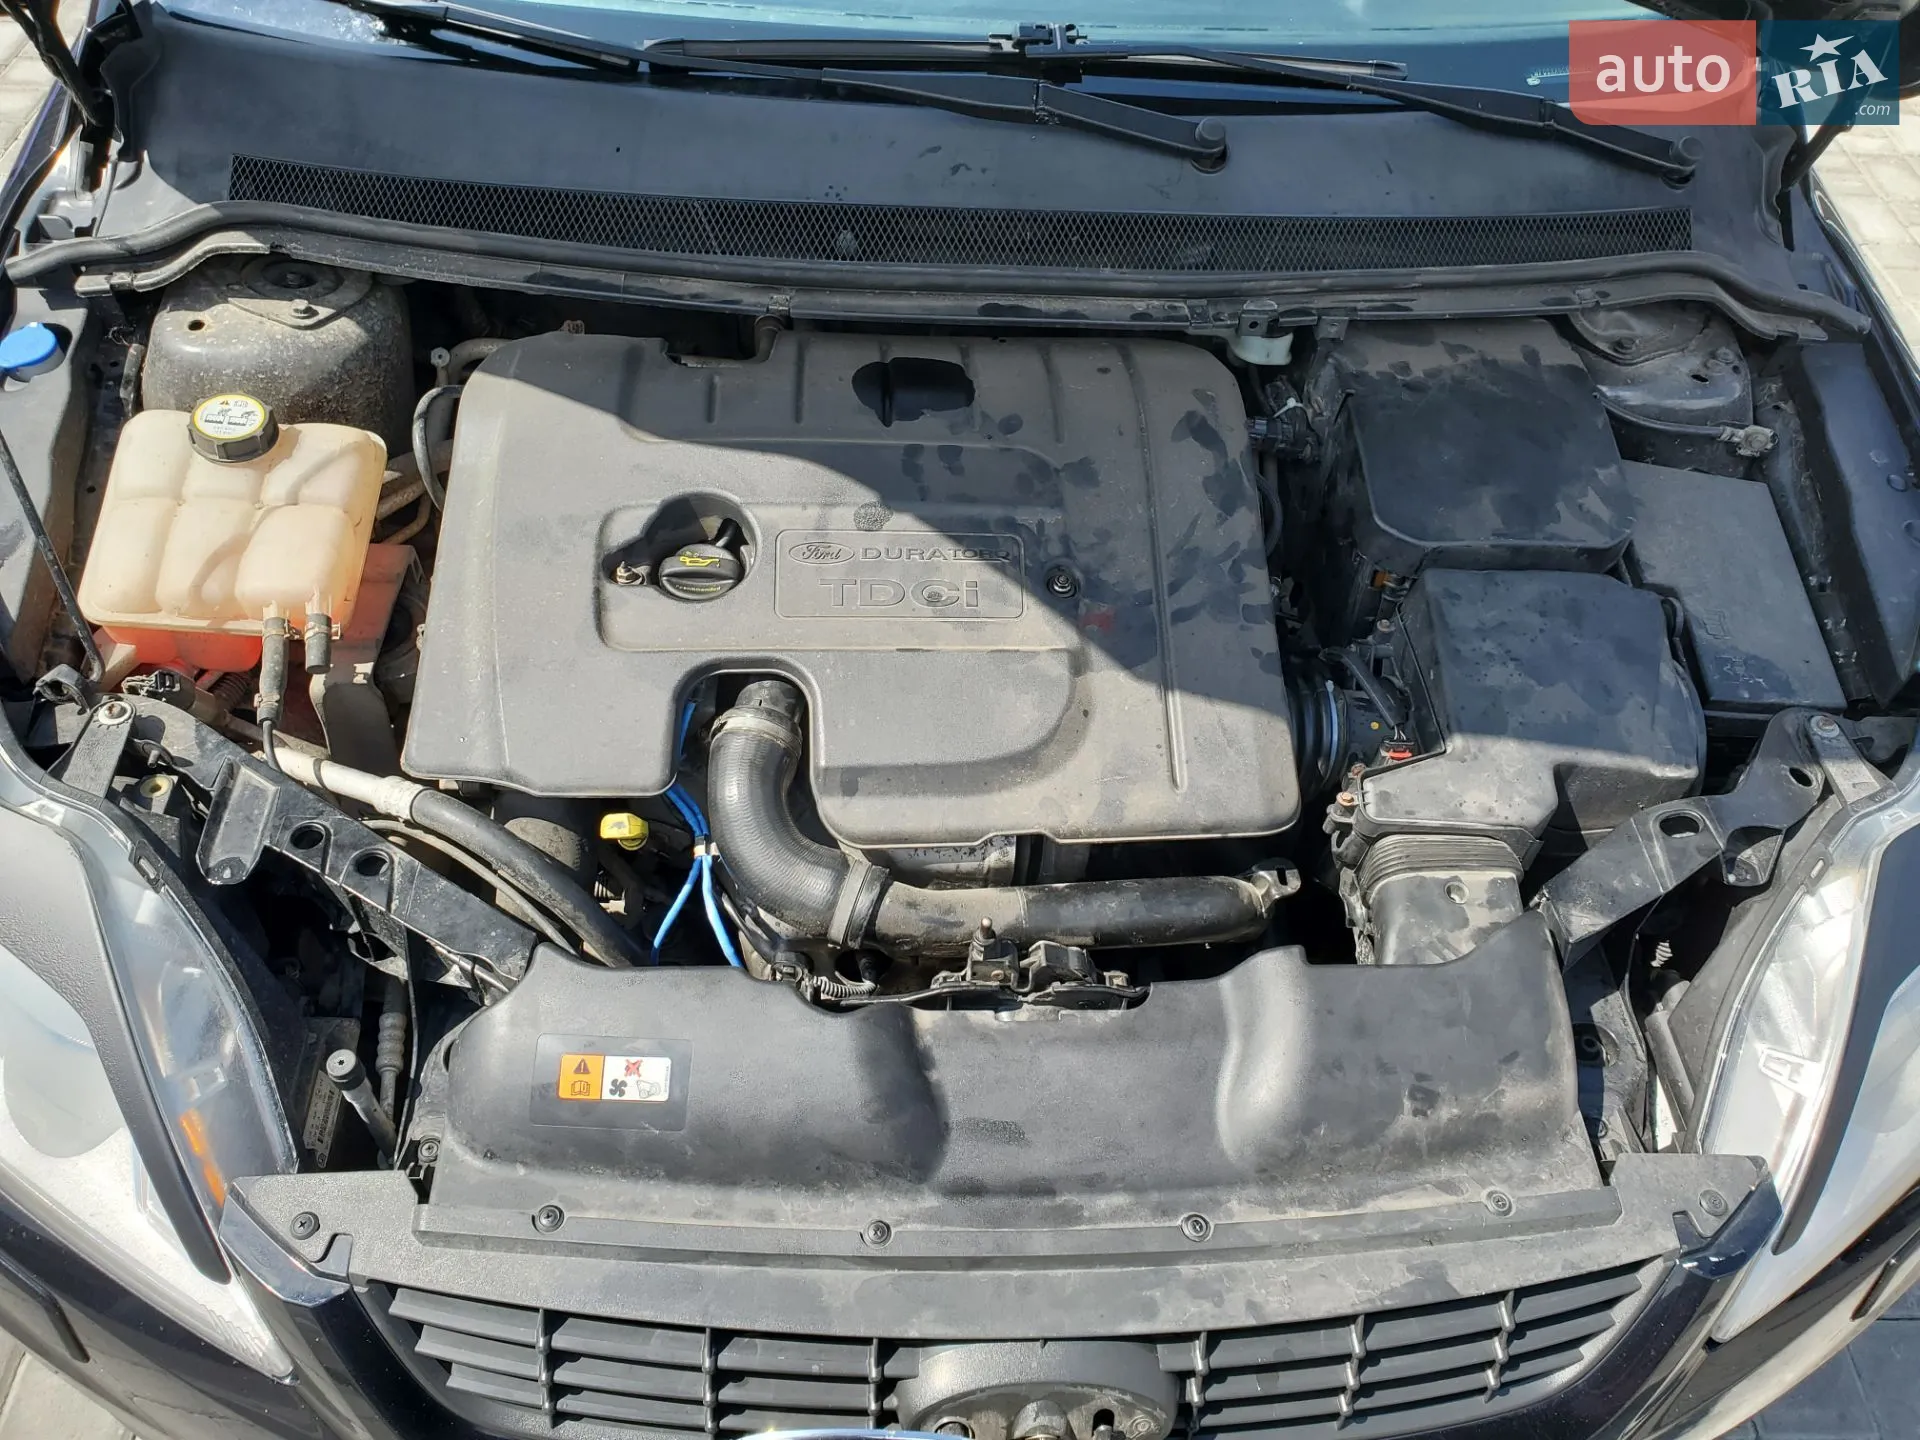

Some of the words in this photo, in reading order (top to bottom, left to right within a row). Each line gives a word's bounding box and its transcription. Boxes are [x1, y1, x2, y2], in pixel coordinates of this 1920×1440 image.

[801, 543, 842, 561] Ford
[860, 546, 1011, 563] DURATORQ
[819, 578, 979, 608] TDCi
